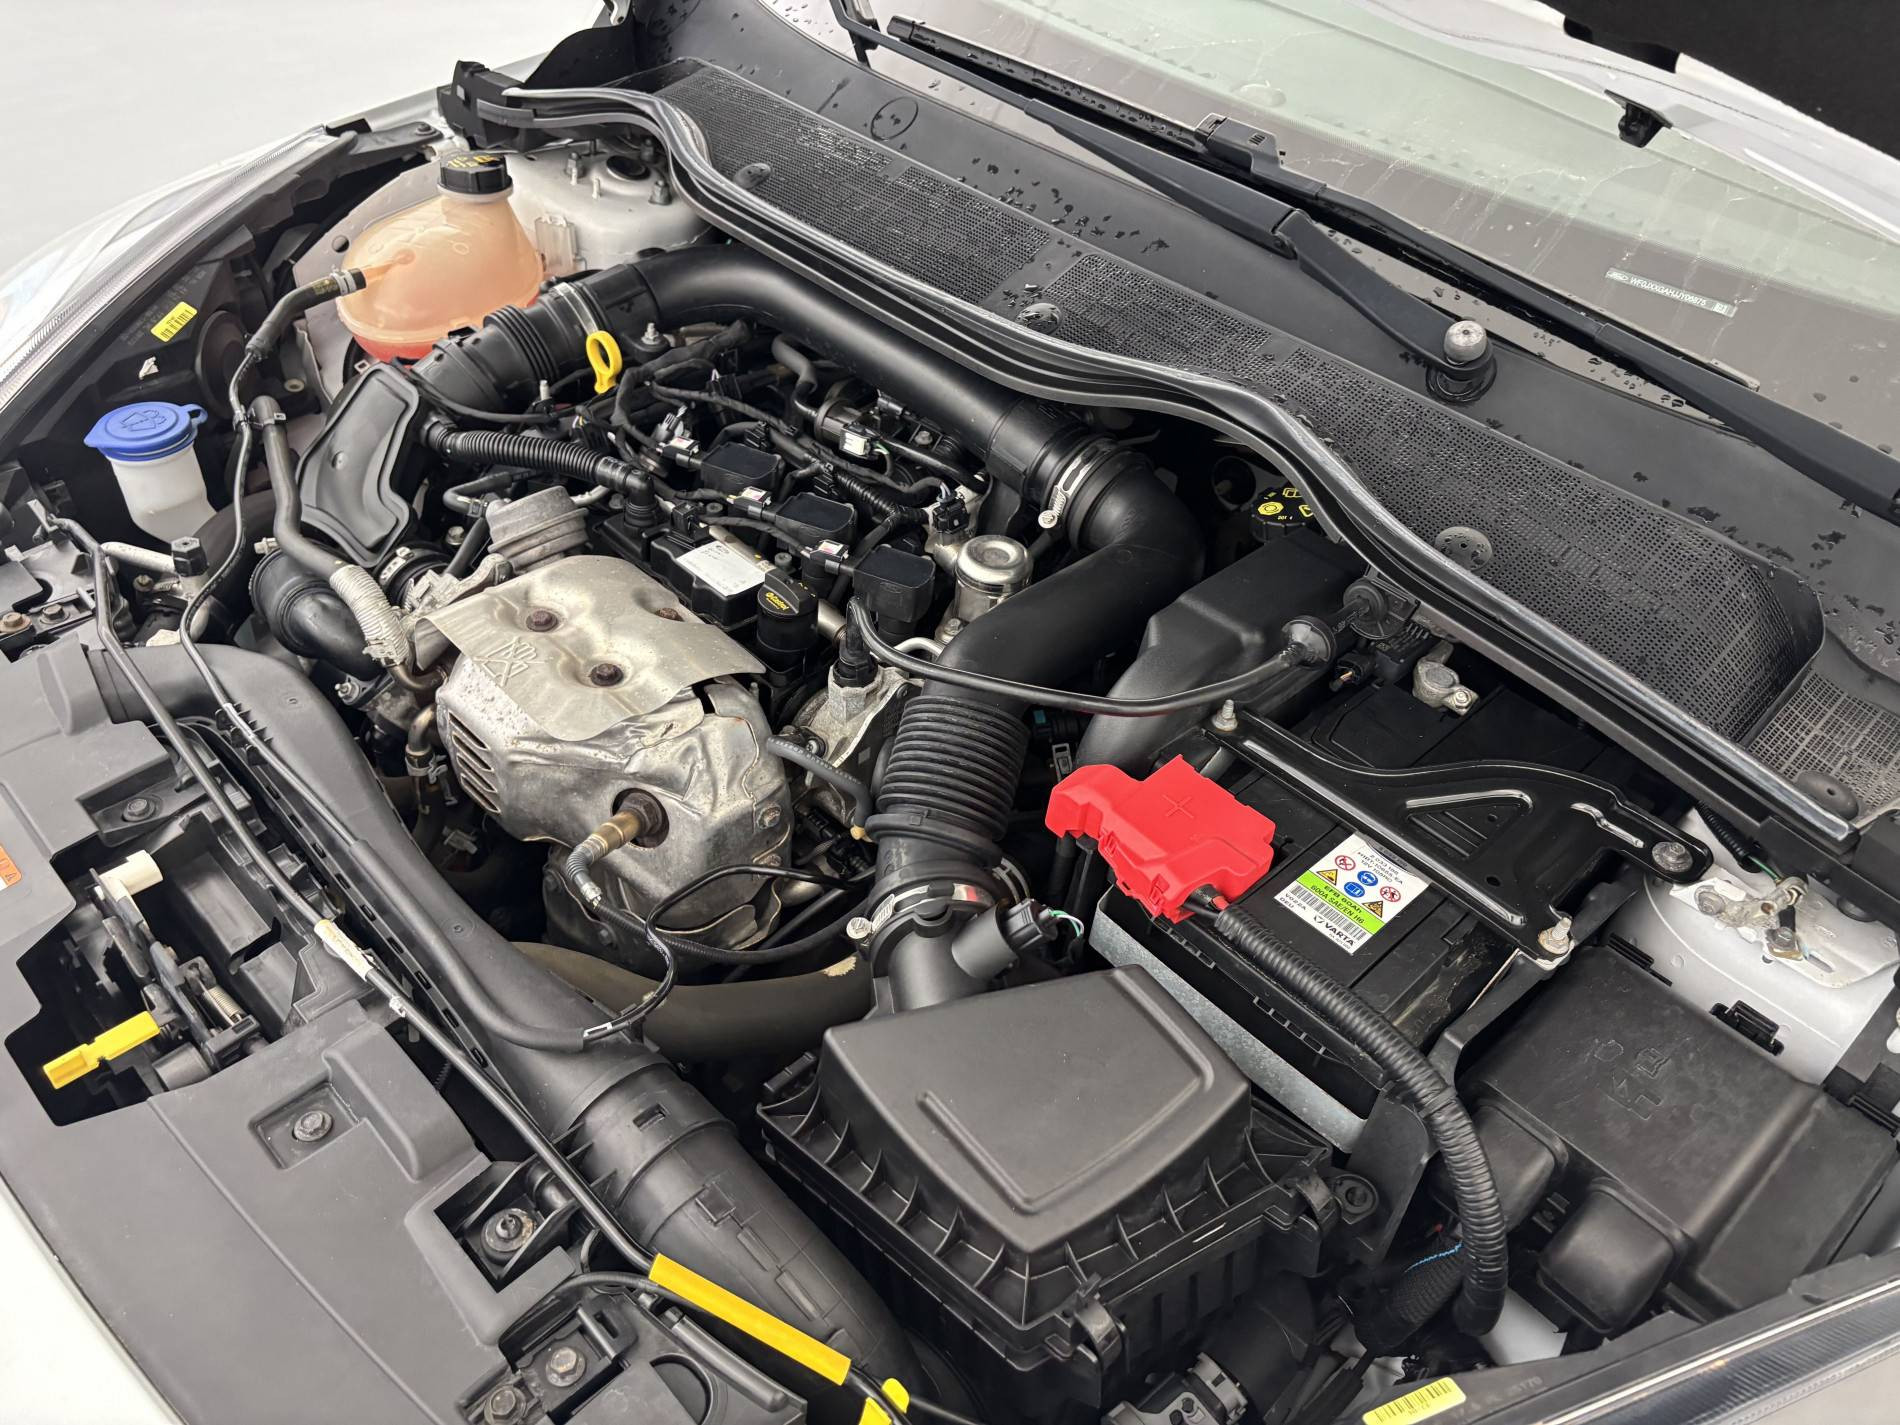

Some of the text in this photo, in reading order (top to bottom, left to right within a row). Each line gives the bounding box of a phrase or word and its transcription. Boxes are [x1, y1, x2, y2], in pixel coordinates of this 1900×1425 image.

[1310, 885, 1329, 900] 600A
[1328, 897, 1354, 917] SAE/EN
[1324, 885, 1340, 898] EFB
[1325, 922, 1354, 946] VARTA
